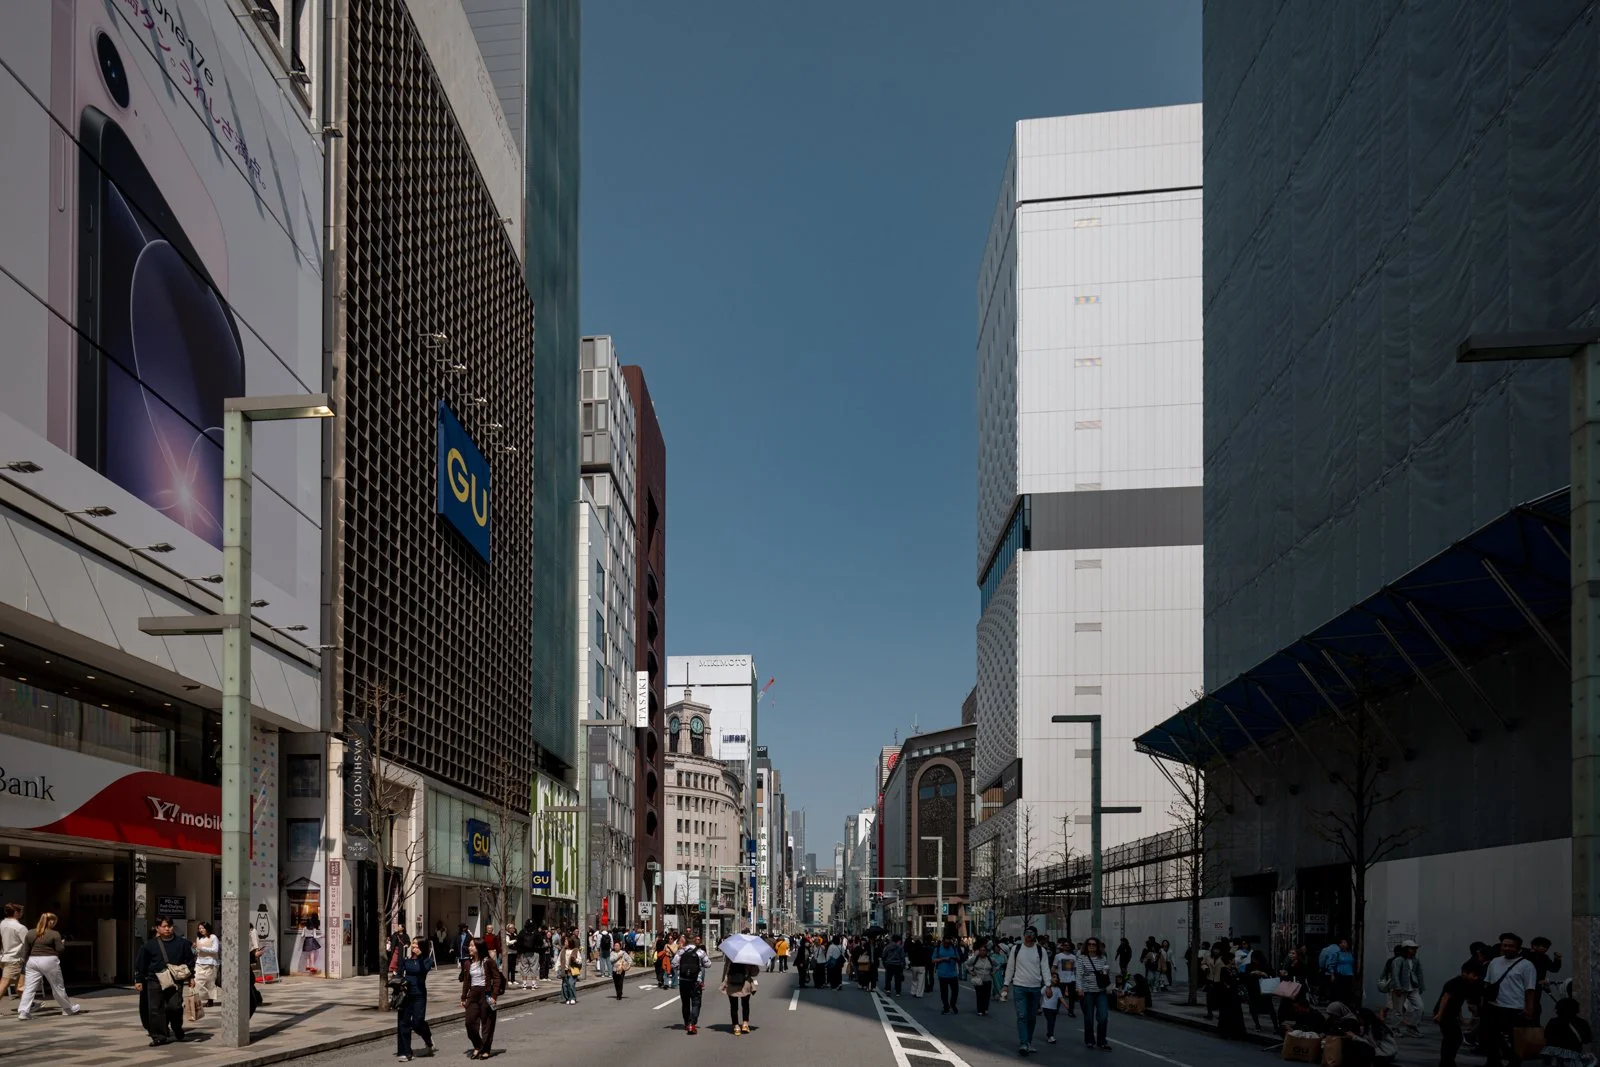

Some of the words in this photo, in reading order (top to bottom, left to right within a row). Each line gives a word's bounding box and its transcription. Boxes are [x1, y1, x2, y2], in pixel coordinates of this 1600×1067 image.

[447, 447, 488, 527] GU
[699, 659, 748, 667] MIKIMOTO
[638, 678, 646, 722] TASAKI
[353, 739, 362, 816] WASHINGTON
[1004, 776, 1016, 792] SONY
[473, 832, 489, 854] GU
[533, 875, 549, 884] GU
